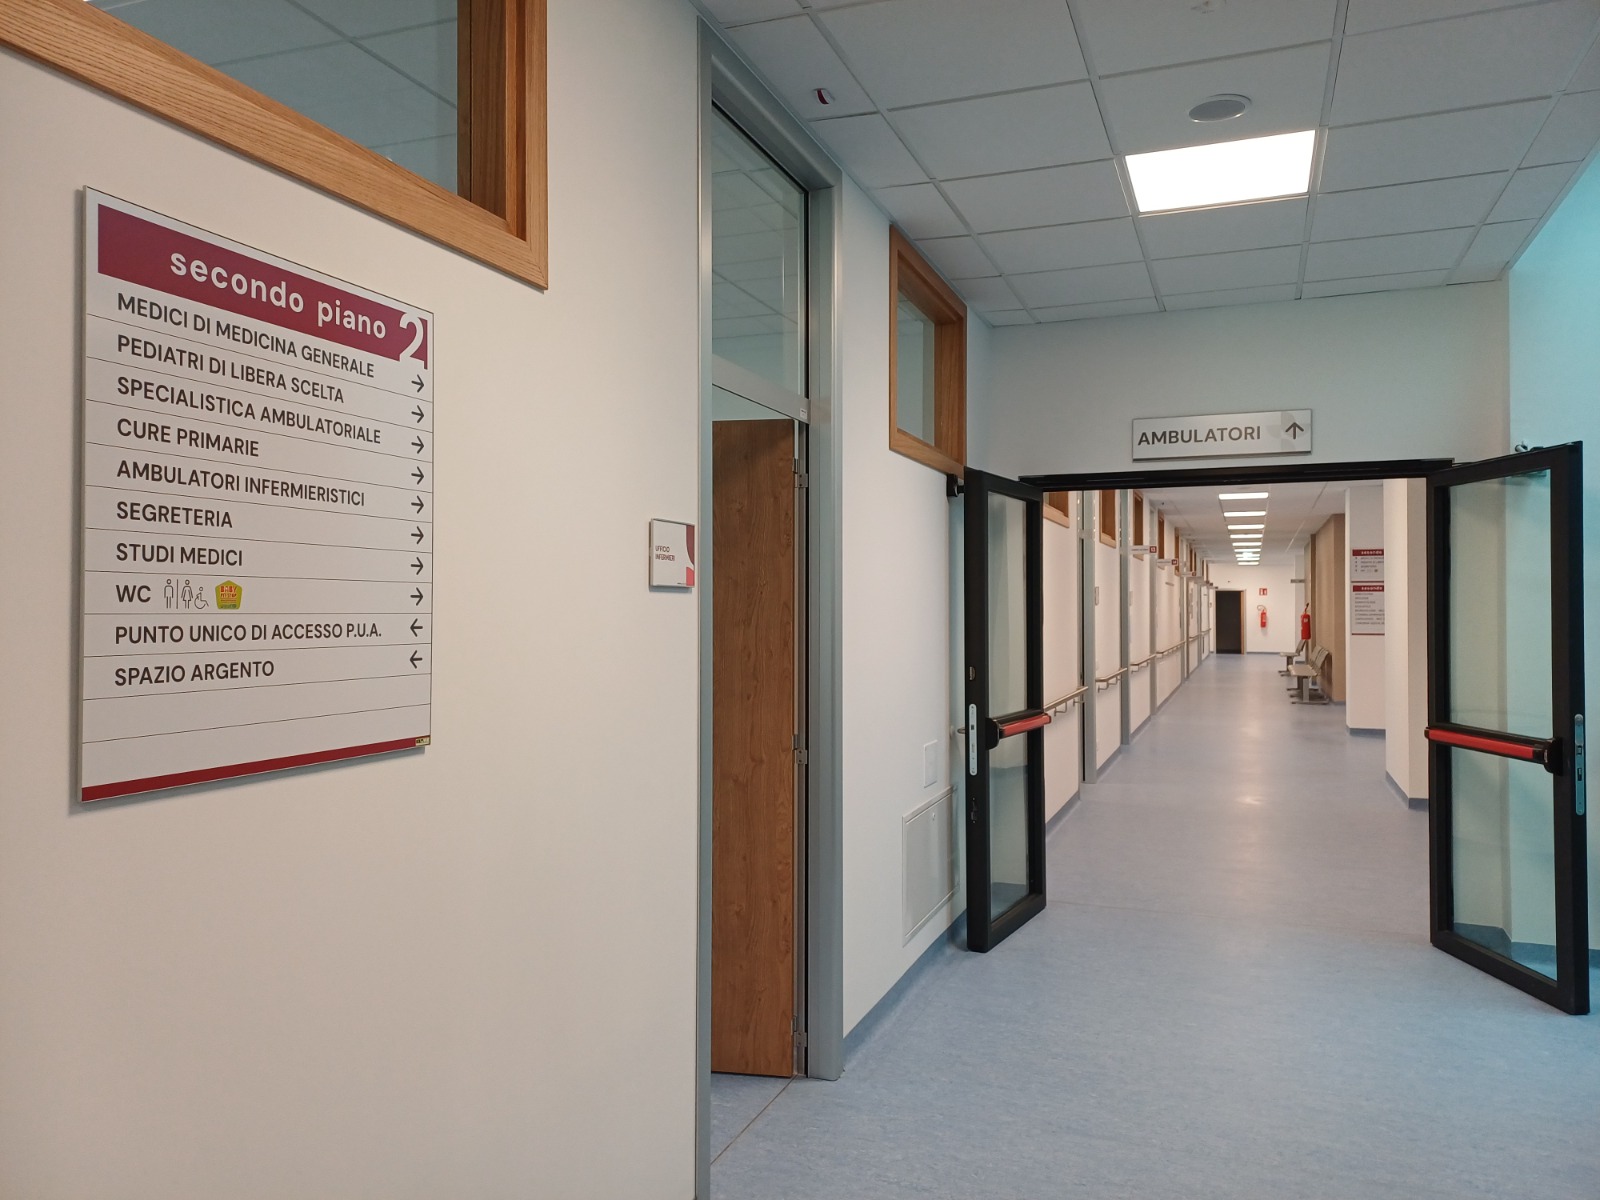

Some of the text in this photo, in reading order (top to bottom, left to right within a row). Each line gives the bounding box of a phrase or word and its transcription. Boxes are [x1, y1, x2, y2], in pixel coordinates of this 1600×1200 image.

[170, 251, 425, 363] secondo piano 2
[118, 292, 374, 378] MEDICI DI MEDICINA GENERALE
[118, 334, 344, 404] PEDIATRI DI LIBERA SCELTA
[117, 376, 381, 445] SPECIALISTICA AMBULATORIALE
[117, 418, 259, 457] CURE PRIMARIE
[1137, 425, 1261, 446] AMBULATORI
[117, 459, 365, 507] AMBULATORI INFERMIERISTICI
[116, 501, 233, 529] SEGRETERIA
[116, 543, 243, 567] STUDI MEDICI
[116, 584, 151, 603] WC
[115, 622, 382, 645] PUNTO UNICO DI ACCESSO P.U.A.
[114, 660, 275, 687] SPAZIO ARGENTO
